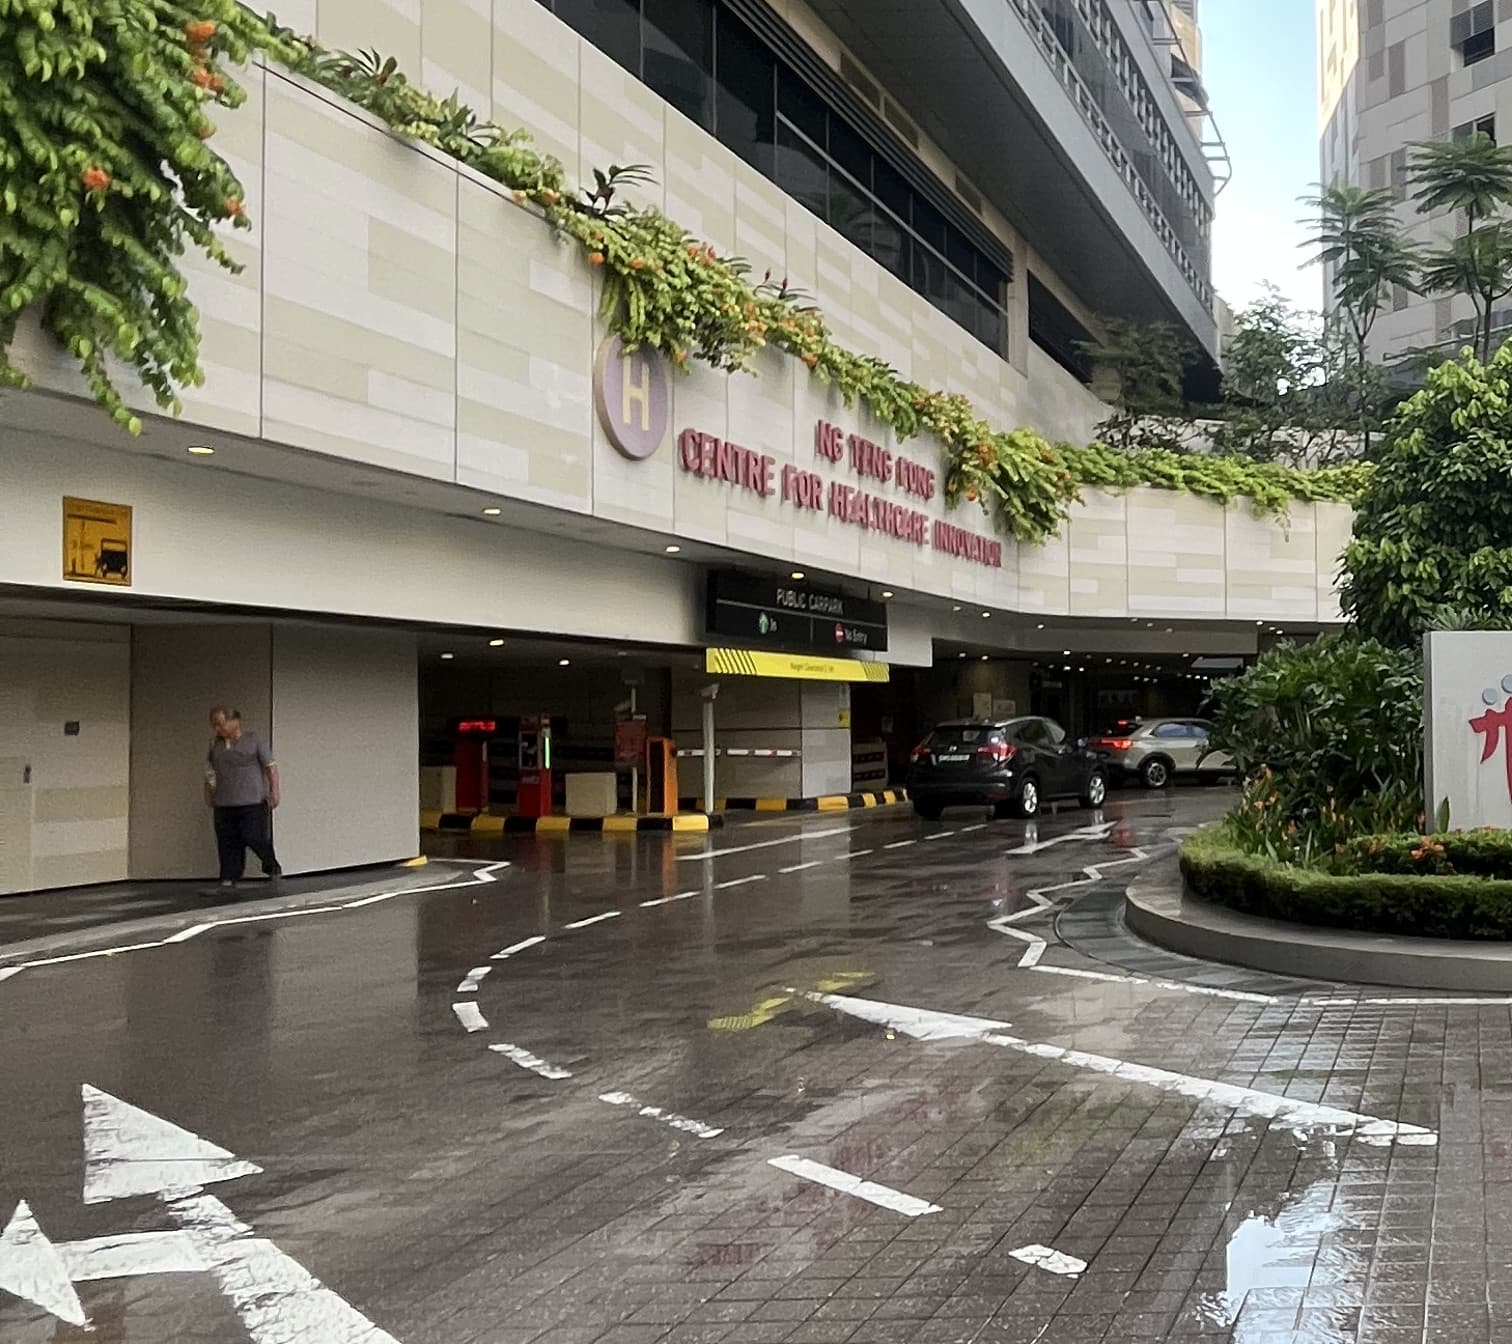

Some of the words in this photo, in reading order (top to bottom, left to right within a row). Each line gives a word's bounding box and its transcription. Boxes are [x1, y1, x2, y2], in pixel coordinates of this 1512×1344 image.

[622, 355, 650, 432] H
[678, 428, 776, 498] CENTRE
[781, 463, 824, 511] FOR
[829, 481, 929, 547] HEALTHCARE
[933, 519, 1002, 568] INNOVATION
[815, 420, 844, 464] NG
[848, 434, 893, 484] TENG
[896, 456, 935, 501] FONG
[776, 588, 806, 609] PUBLIC
